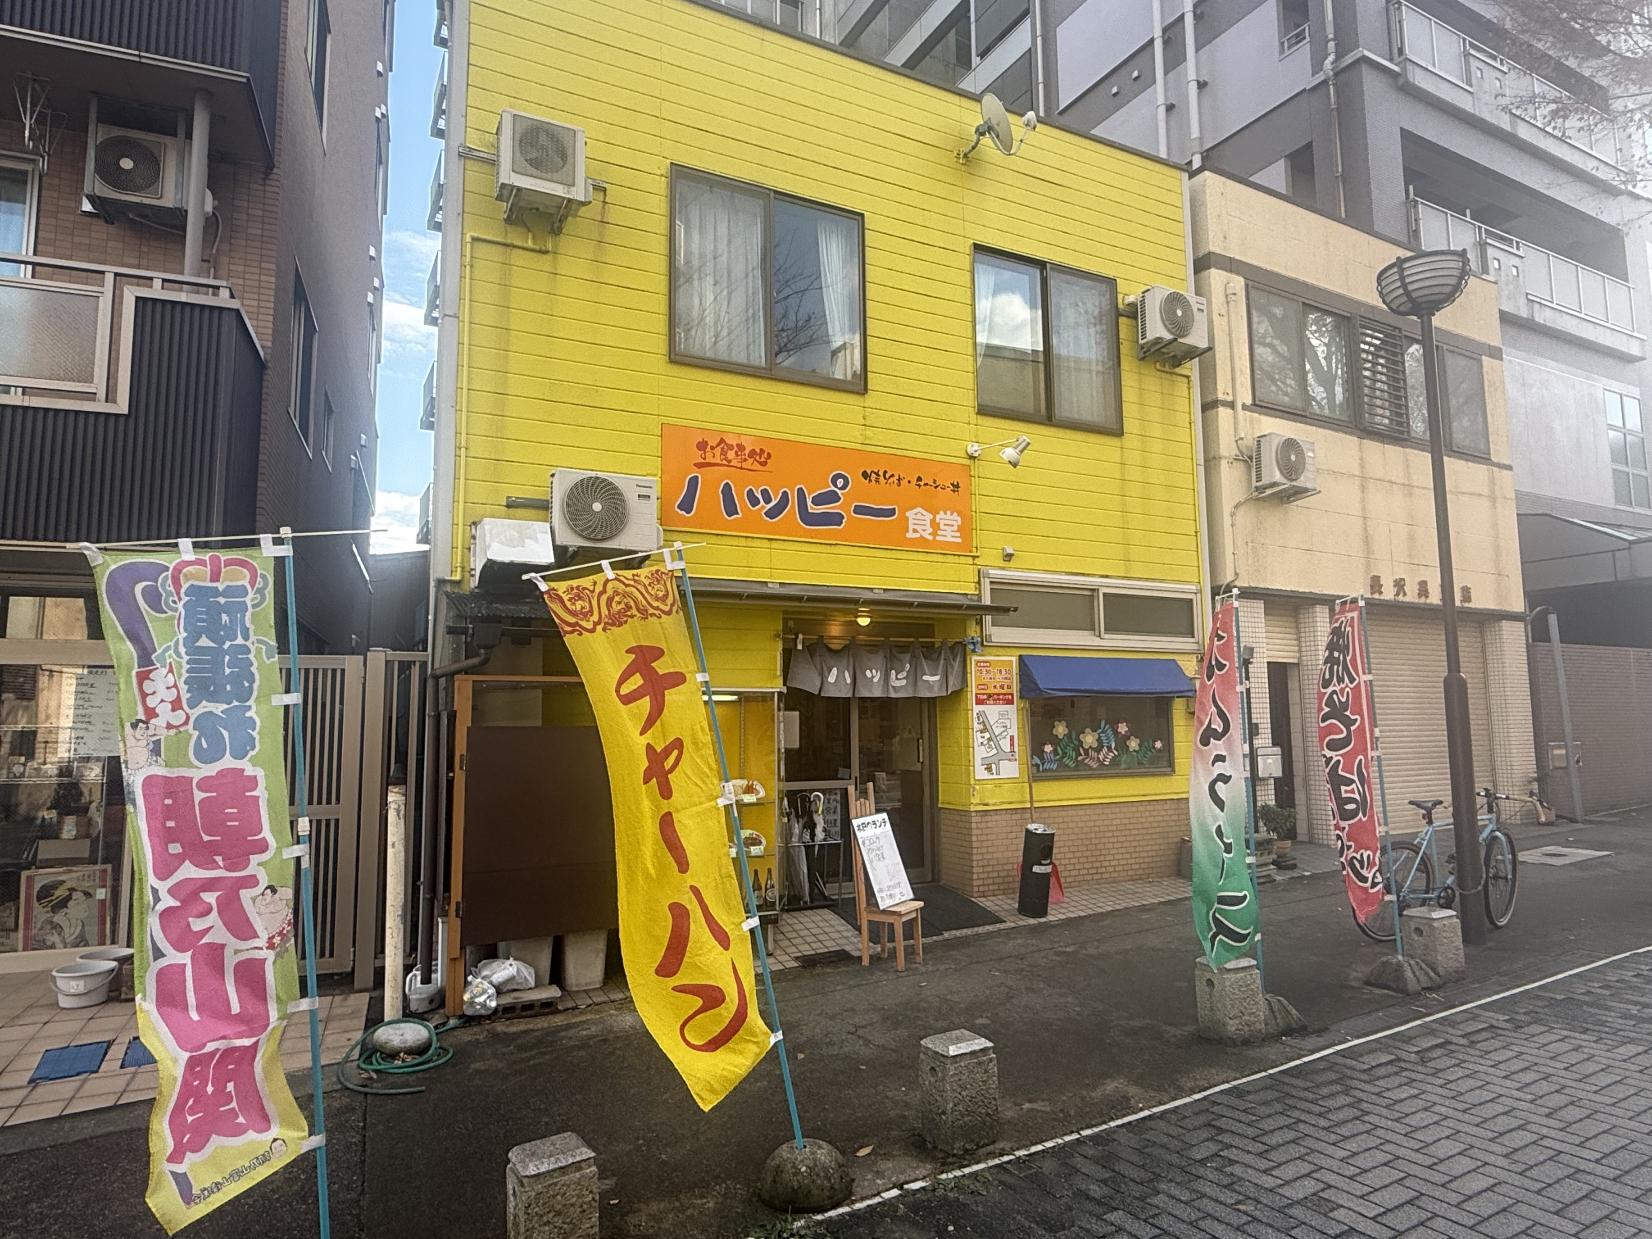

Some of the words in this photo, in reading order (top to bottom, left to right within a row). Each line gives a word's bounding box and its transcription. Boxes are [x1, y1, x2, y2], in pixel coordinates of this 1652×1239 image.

[696, 437, 772, 469] お食事処
[827, 663, 941, 688] ハッピー
[615, 644, 749, 1053] チャーハン
